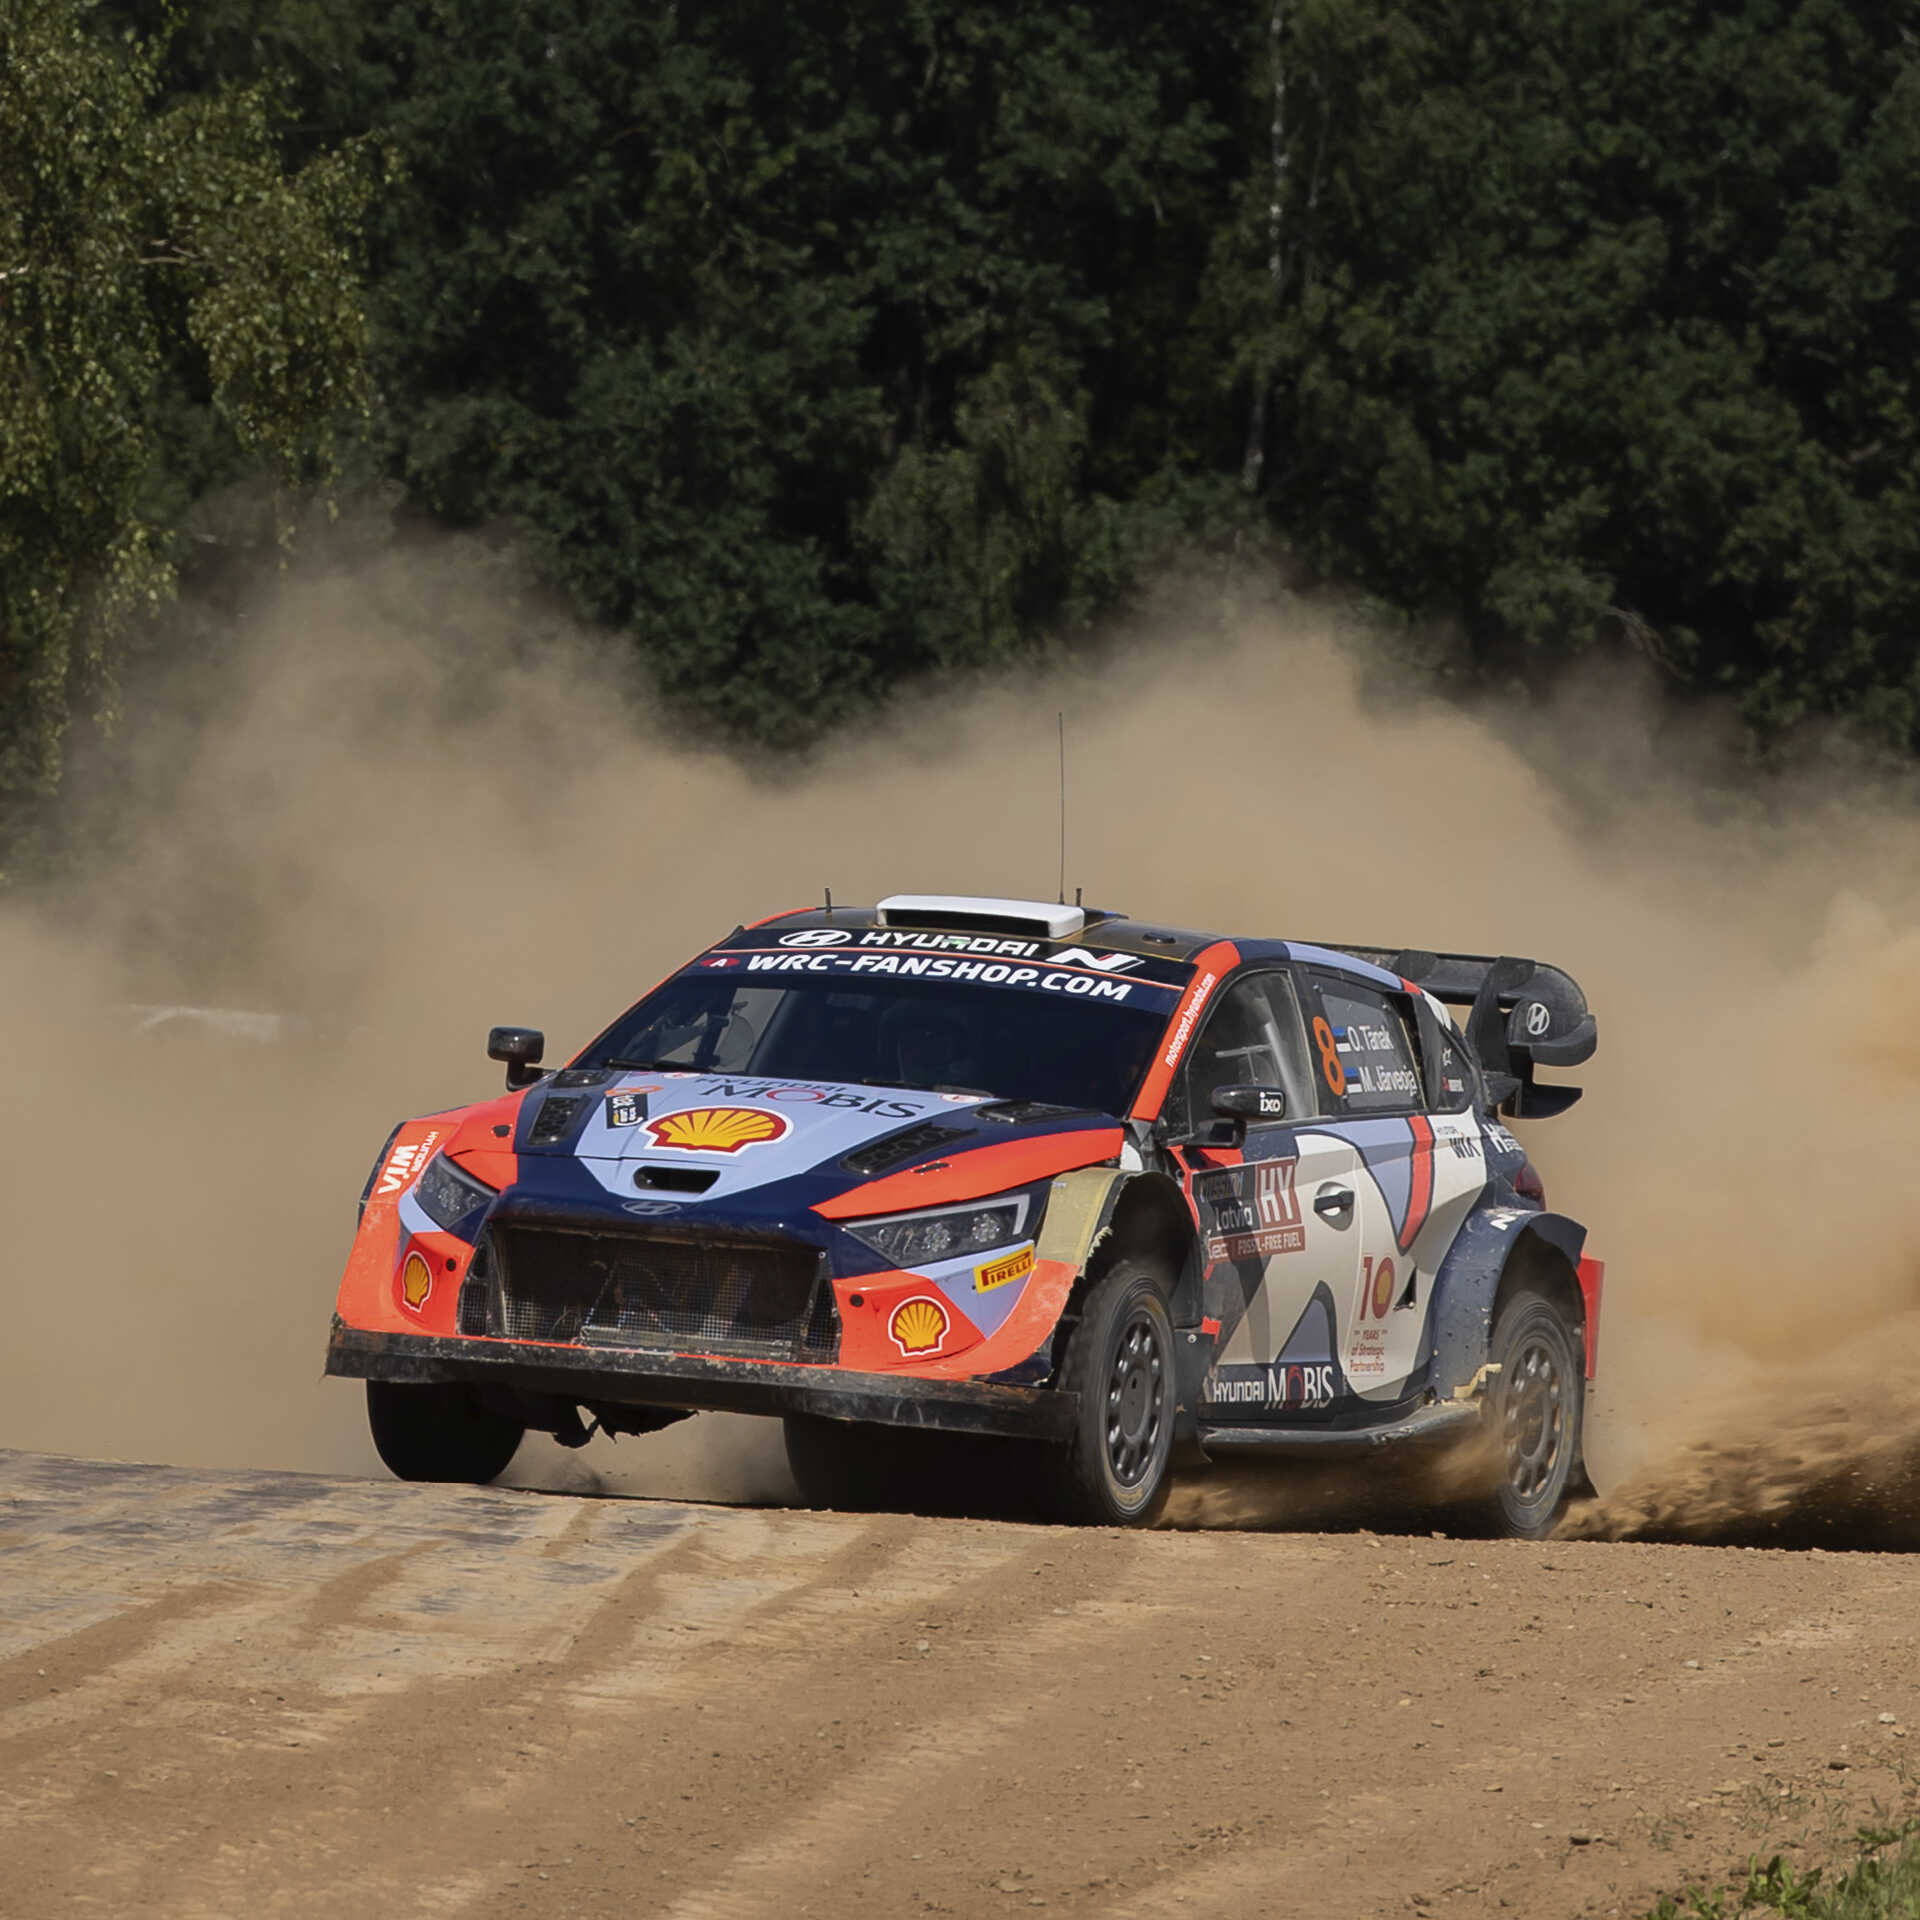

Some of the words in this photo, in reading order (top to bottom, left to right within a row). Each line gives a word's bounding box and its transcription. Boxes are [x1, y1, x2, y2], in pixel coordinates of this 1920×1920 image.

[859, 932, 1041, 958] HYUNDAI
[746, 954, 1132, 1000] WRC-FANSHOP.COM
[1165, 972, 1216, 1068] motorsport.hyundai.com
[1347, 1025, 1363, 1051] O.
[1312, 1015, 1345, 1097] 8
[1359, 1066, 1376, 1092] M.
[702, 1085, 927, 1119] MOBIS
[1261, 1165, 1294, 1223] HY
[1214, 1200, 1254, 1232] Latvia
[981, 1251, 1031, 1287] PIRELLI
[1213, 1380, 1265, 1402] HYUNDAI
[1267, 1365, 1335, 1403] MOBIS
